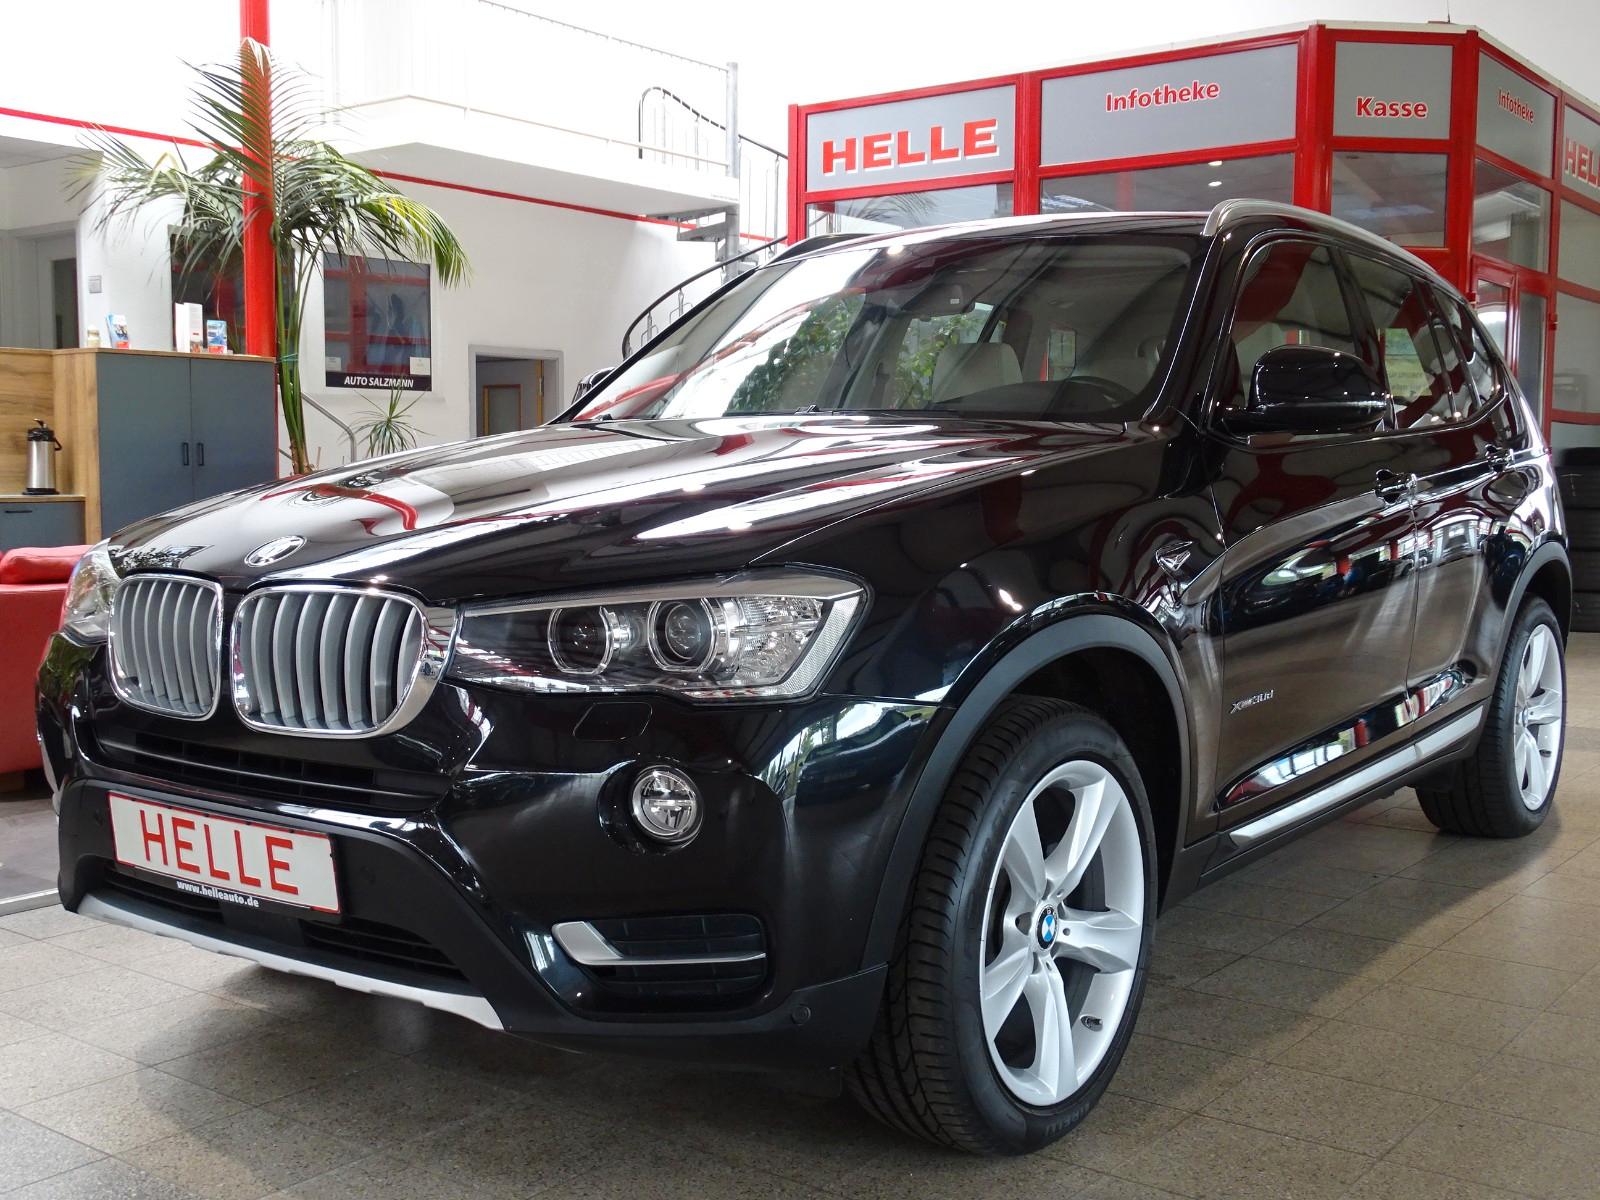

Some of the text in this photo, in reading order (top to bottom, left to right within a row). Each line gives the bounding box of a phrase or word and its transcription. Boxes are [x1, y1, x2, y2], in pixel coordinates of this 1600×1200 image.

[1105, 80, 1221, 113] Infotheke
[1355, 96, 1429, 119] Kasse
[1497, 88, 1535, 126] Infotheke
[822, 118, 999, 177] HELLE
[344, 376, 414, 388] AUTO SALZMANN
[140, 809, 299, 896] HELLE
[175, 880, 260, 908] www.helleauto.de
